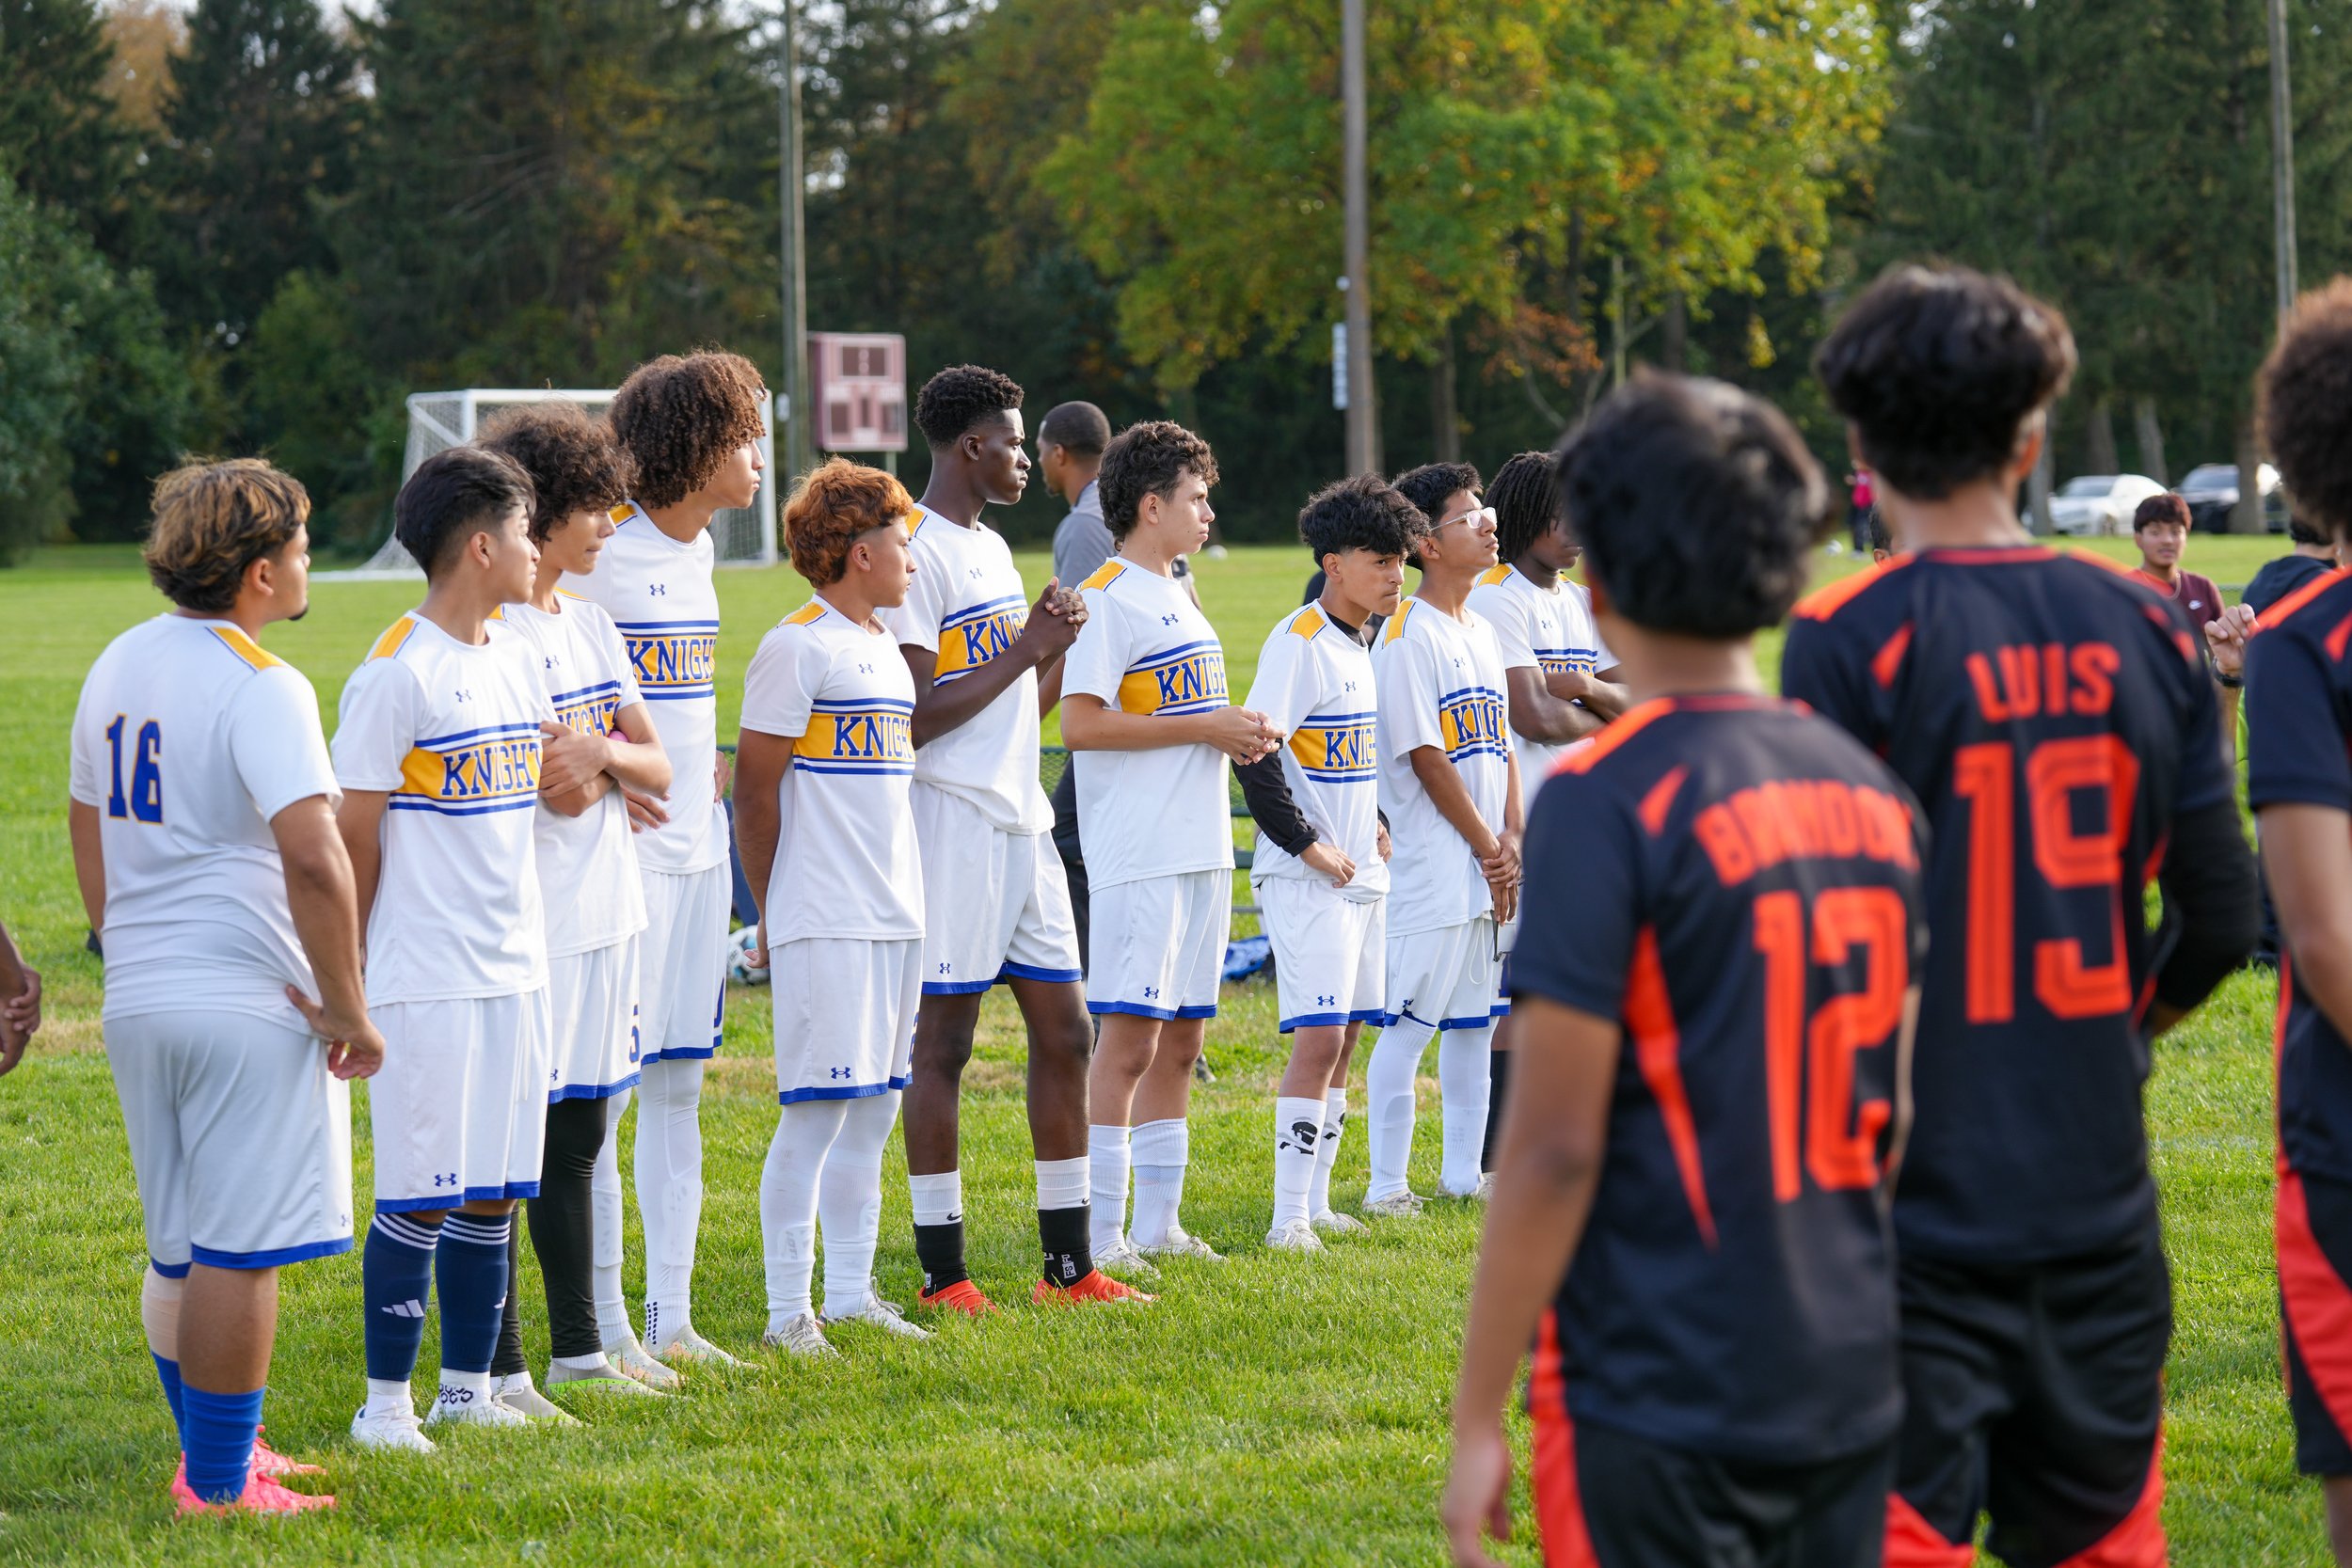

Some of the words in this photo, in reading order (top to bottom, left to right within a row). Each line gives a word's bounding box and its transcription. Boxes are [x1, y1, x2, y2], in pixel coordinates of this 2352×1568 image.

[105, 713, 164, 825] 16
[1967, 642, 2121, 721] LUIS
[1955, 735, 2139, 1022] 19
[1754, 888, 1908, 1202] 12
